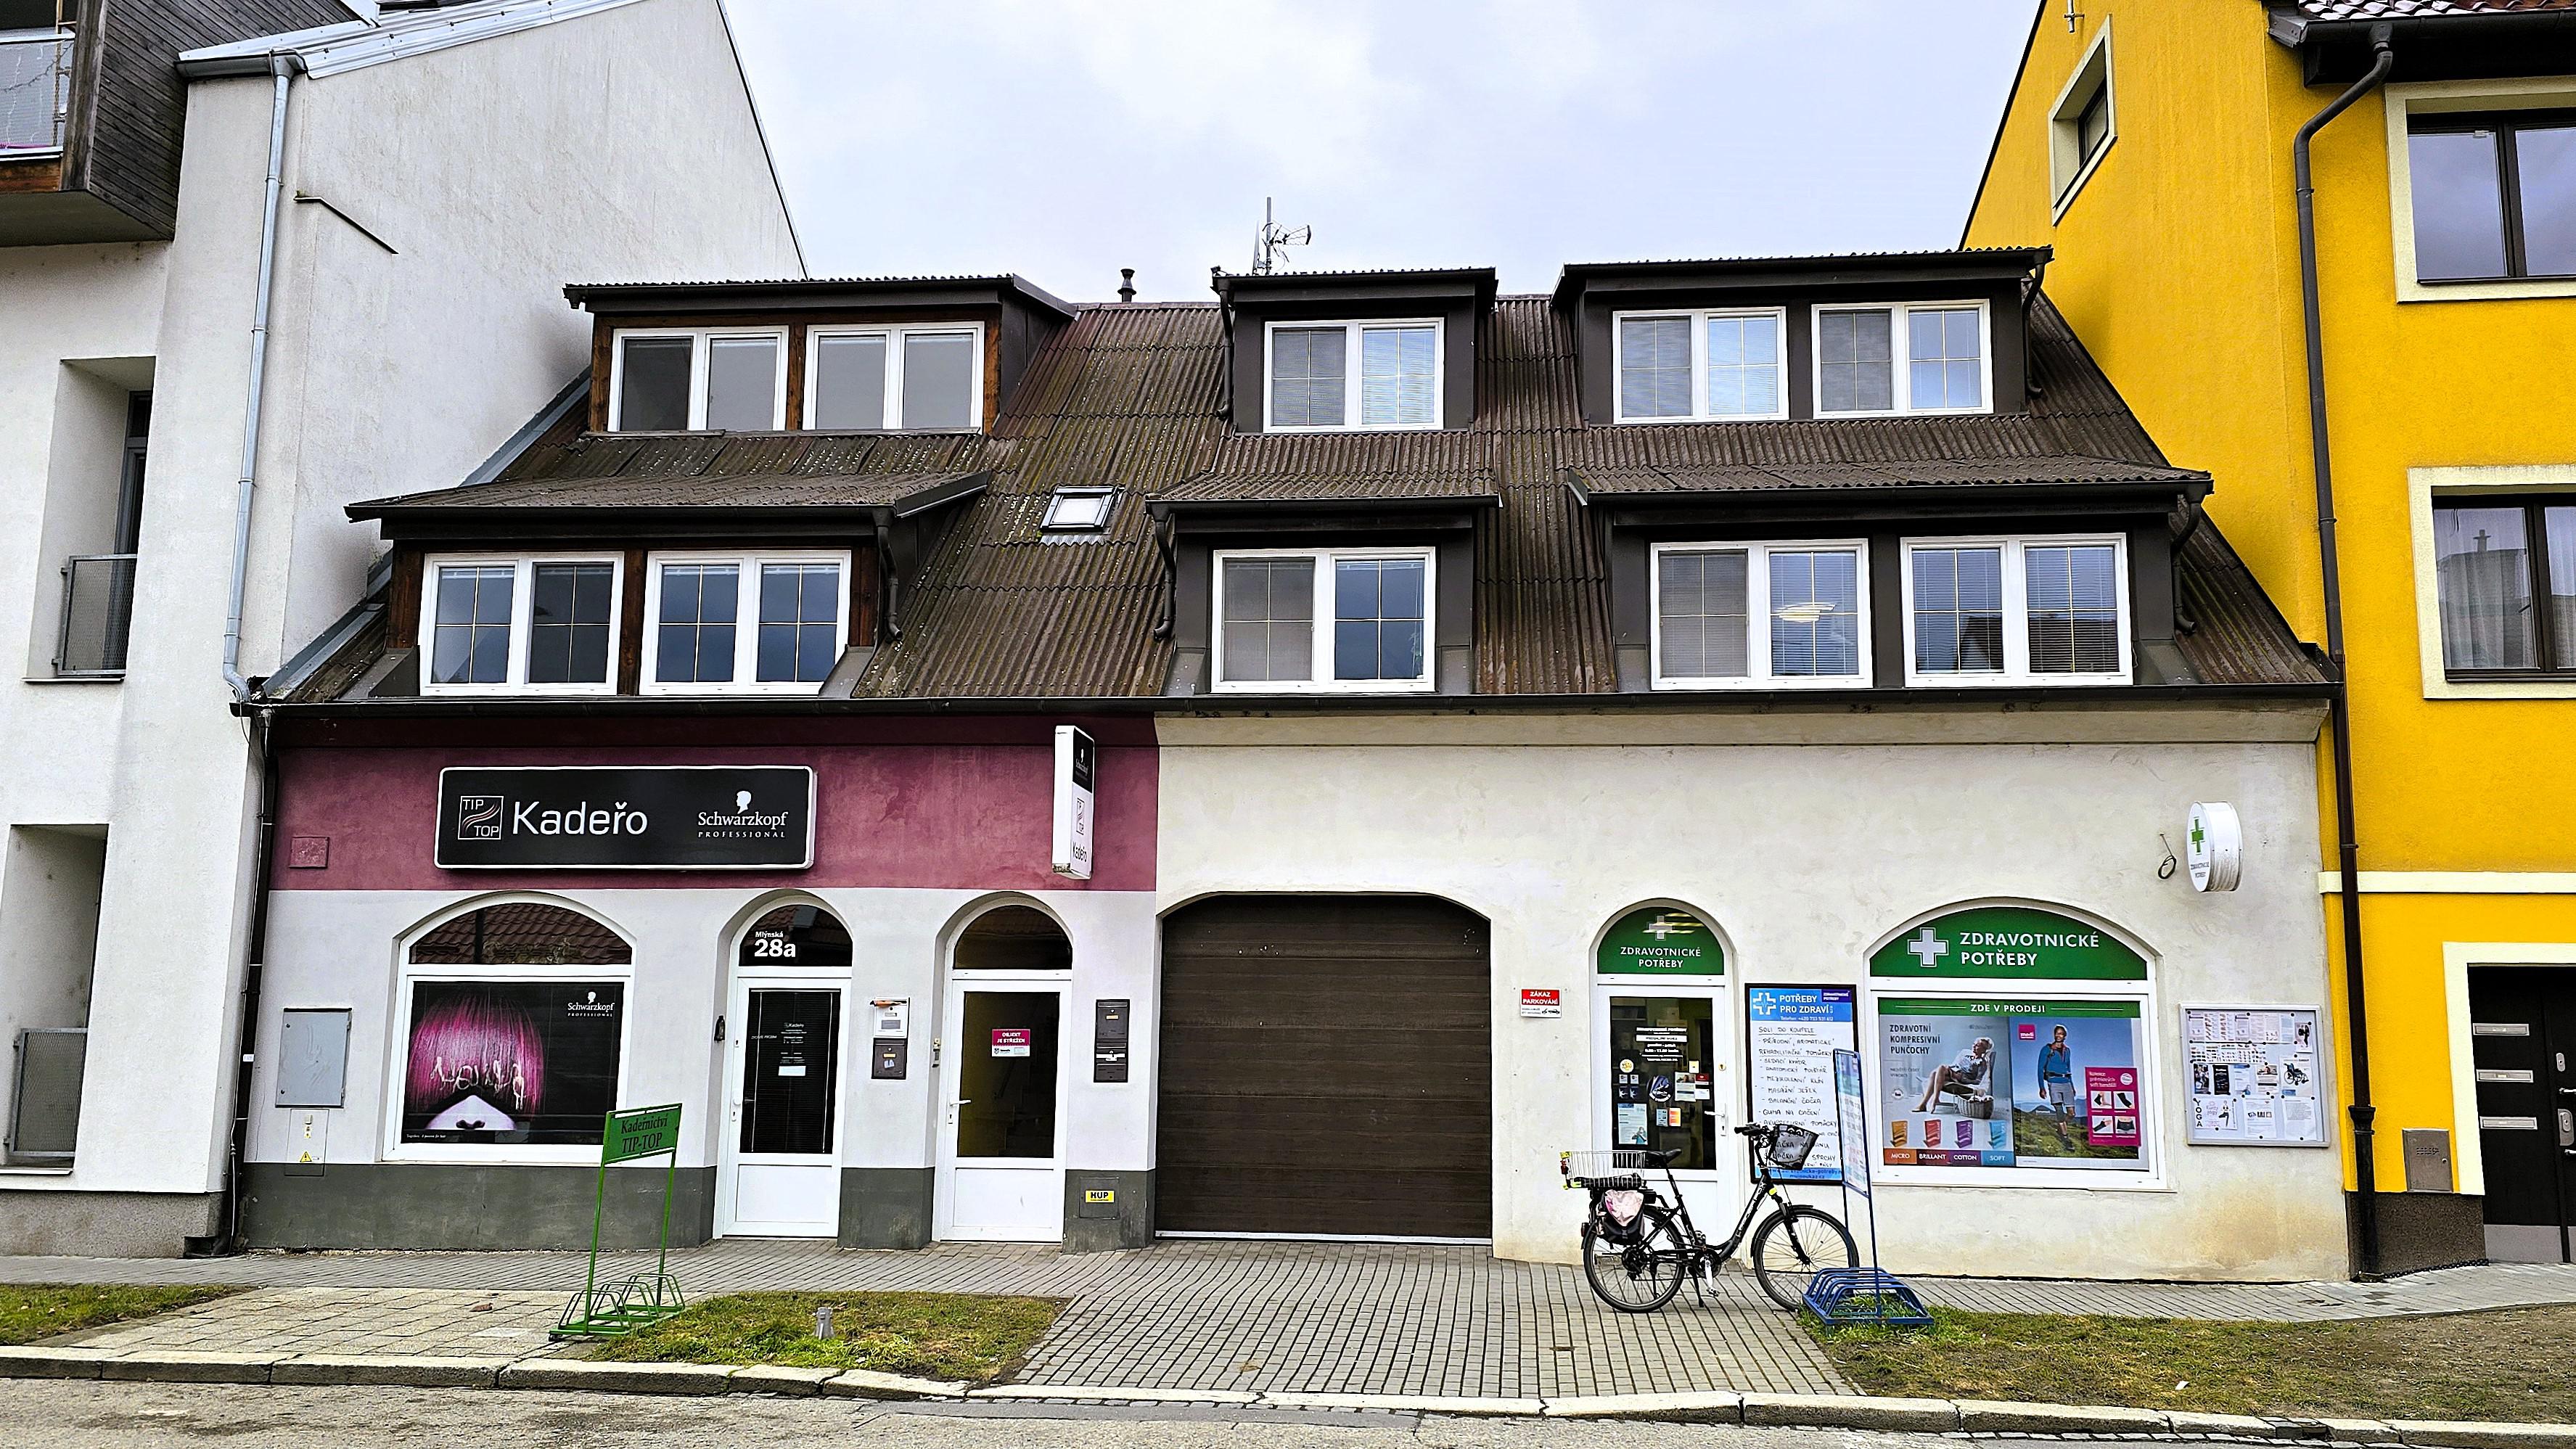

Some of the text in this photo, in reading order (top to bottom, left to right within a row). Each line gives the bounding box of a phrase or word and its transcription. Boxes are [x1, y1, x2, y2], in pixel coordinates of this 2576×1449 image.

[462, 799, 484, 808] TIP
[512, 801, 648, 835] Kadeřo
[697, 811, 788, 830] Schwarzkopf
[473, 825, 499, 837] TOP
[755, 930, 784, 939] Mlýnská
[1960, 931, 2099, 948] ZDRAVOTNICKÉ
[755, 939, 796, 957] 28a
[1620, 946, 1701, 957] ZDRAVOTNICKÉ
[1638, 957, 1683, 968] POTŘEBY
[1961, 950, 2038, 966] POTŘEBY
[1780, 993, 1817, 1003] POTŘEBY
[568, 1002, 615, 1012] Schwarzkopf
[1800, 1003, 1829, 1013] ZDRAVÍ
[1890, 1023, 1931, 1033] ZDRAVOTNÍ
[1890, 1034, 1940, 1043] KOMPRESIVNÍ
[1890, 1046, 1929, 1054] PUNČOCHY
[621, 1114, 668, 1134] Kadeřnictví
[623, 1133, 663, 1154] TIP-TOP
